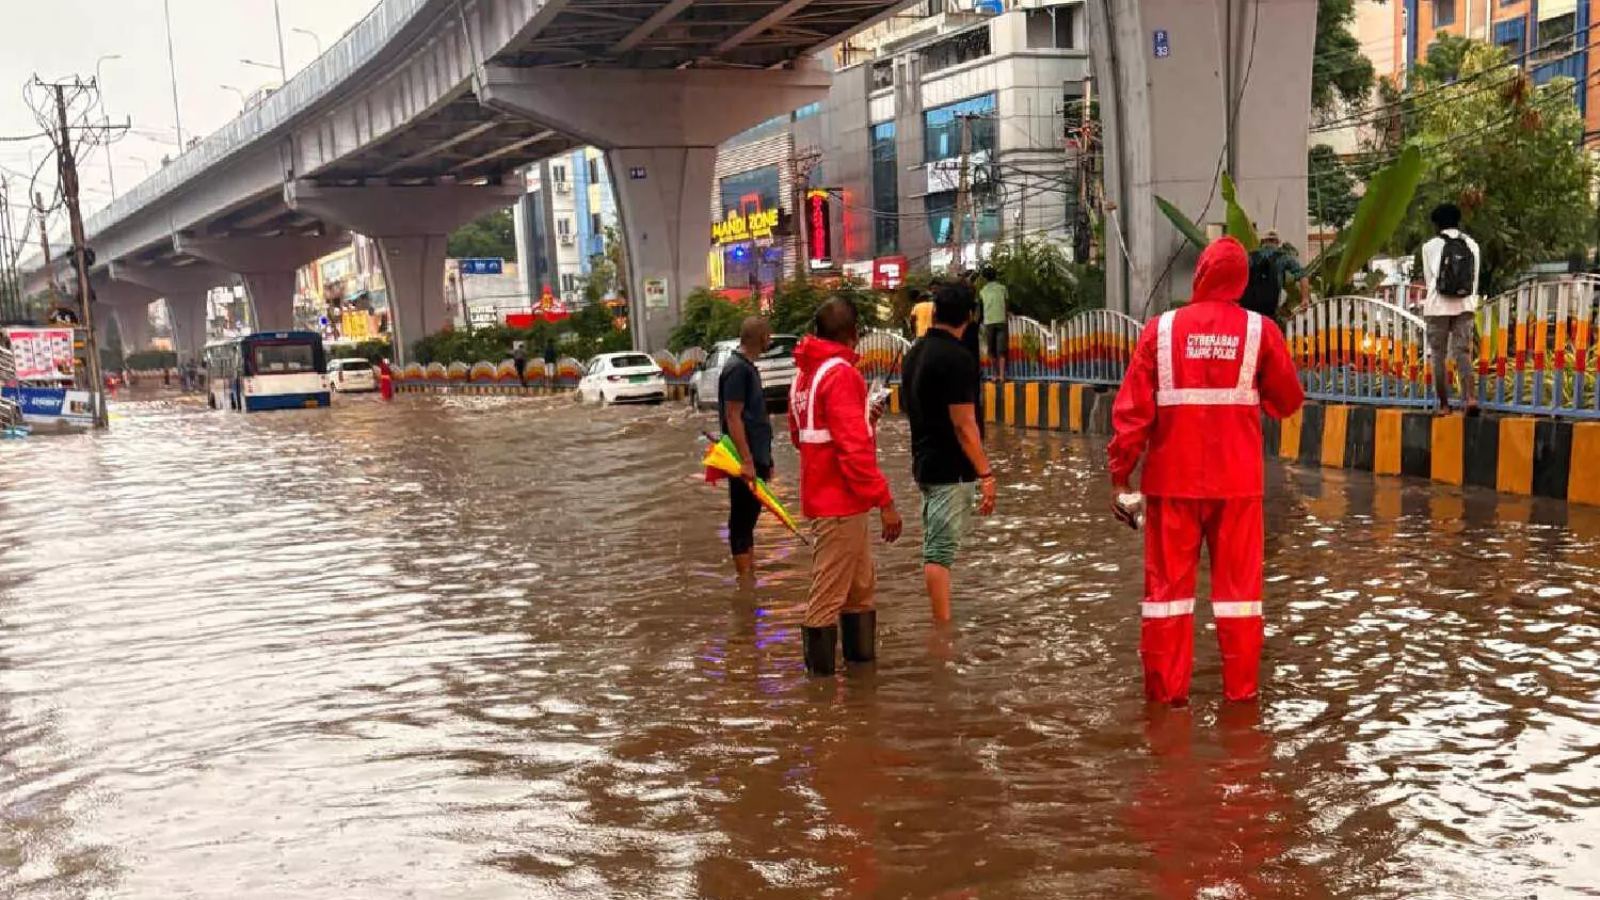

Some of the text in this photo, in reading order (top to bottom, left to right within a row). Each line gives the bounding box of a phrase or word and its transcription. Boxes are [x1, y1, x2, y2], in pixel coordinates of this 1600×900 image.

[713, 217, 746, 238] MANDI
[749, 208, 779, 230] ZONE
[1187, 334, 1239, 348] CYBERABAD
[1185, 346, 1236, 360] TRAFFIC POLICE
